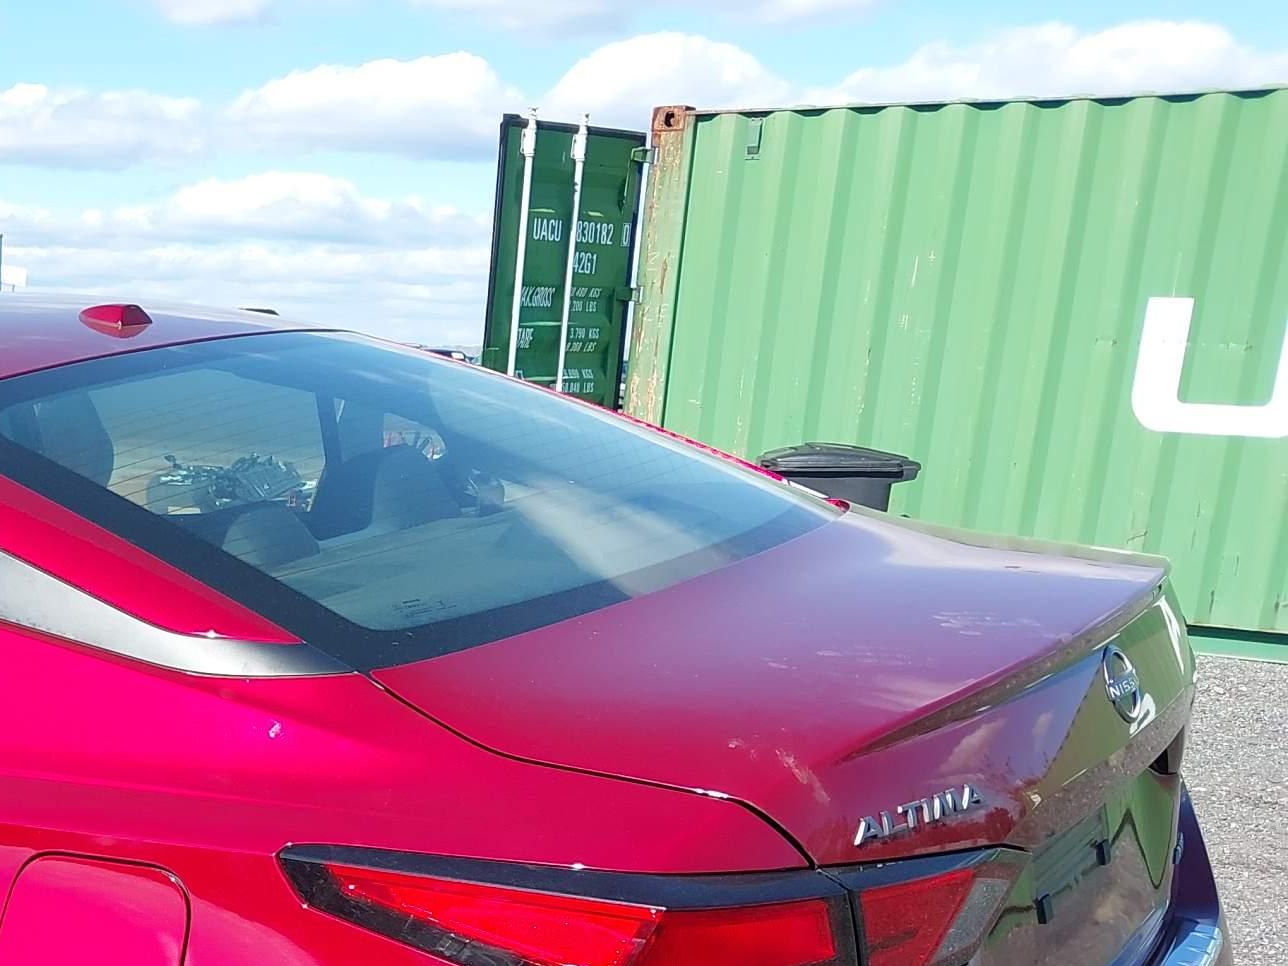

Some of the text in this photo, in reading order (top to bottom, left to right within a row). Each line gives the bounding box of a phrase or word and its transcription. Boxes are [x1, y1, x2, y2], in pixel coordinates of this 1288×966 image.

[533, 218, 562, 241] UACU
[576, 221, 614, 245] 830182
[573, 251, 597, 275] 42G1
[853, 783, 983, 847] ALTIMA
